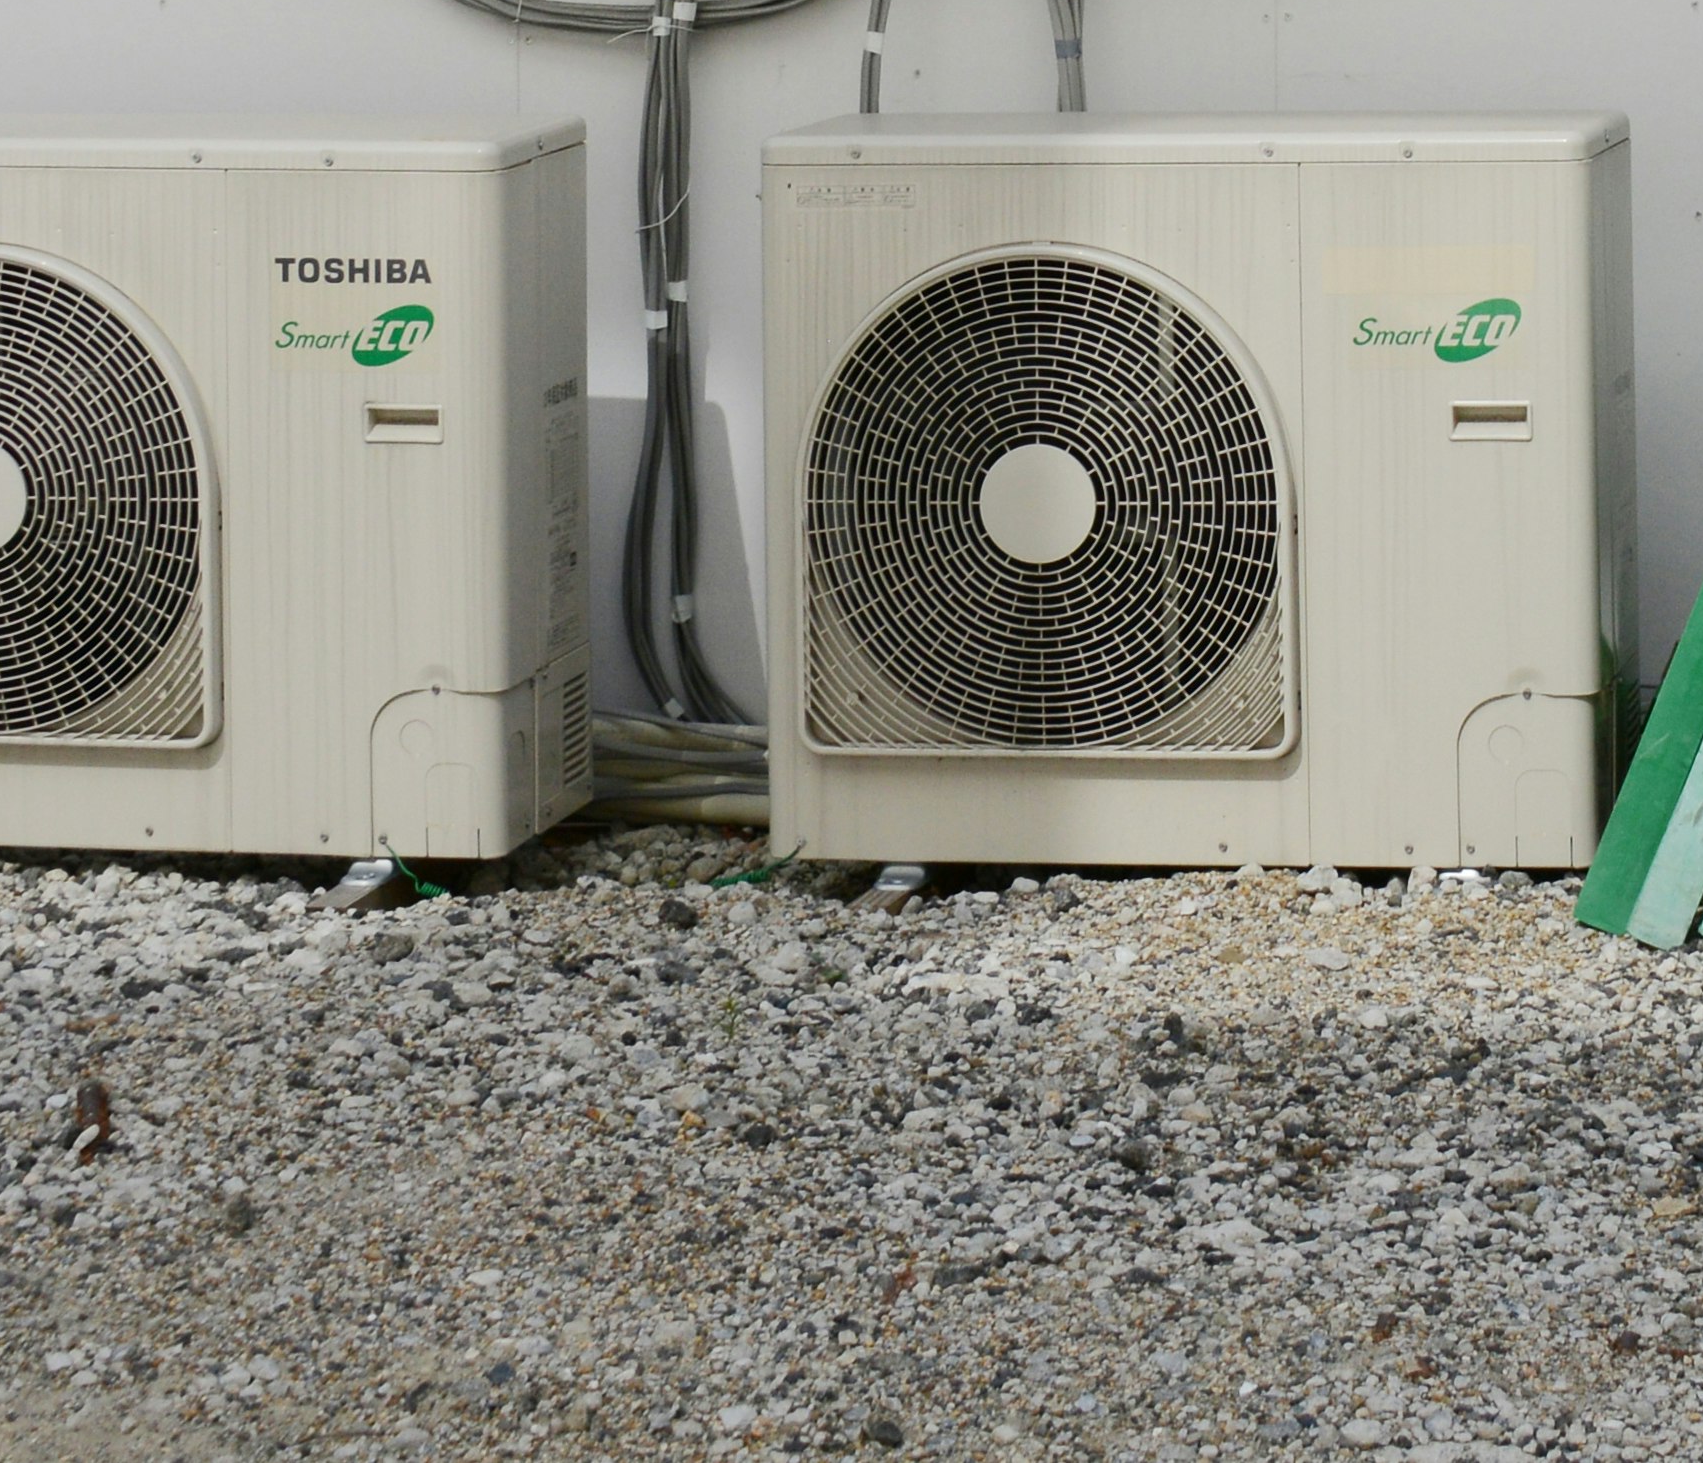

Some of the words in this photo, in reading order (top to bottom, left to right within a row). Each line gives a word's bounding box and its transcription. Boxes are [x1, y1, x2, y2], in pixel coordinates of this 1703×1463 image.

[274, 256, 433, 285] TOSHIBA
[274, 320, 352, 350] Smart
[354, 319, 431, 352] ECO
[1352, 316, 1434, 347] Smart
[1437, 313, 1518, 348] ECO
